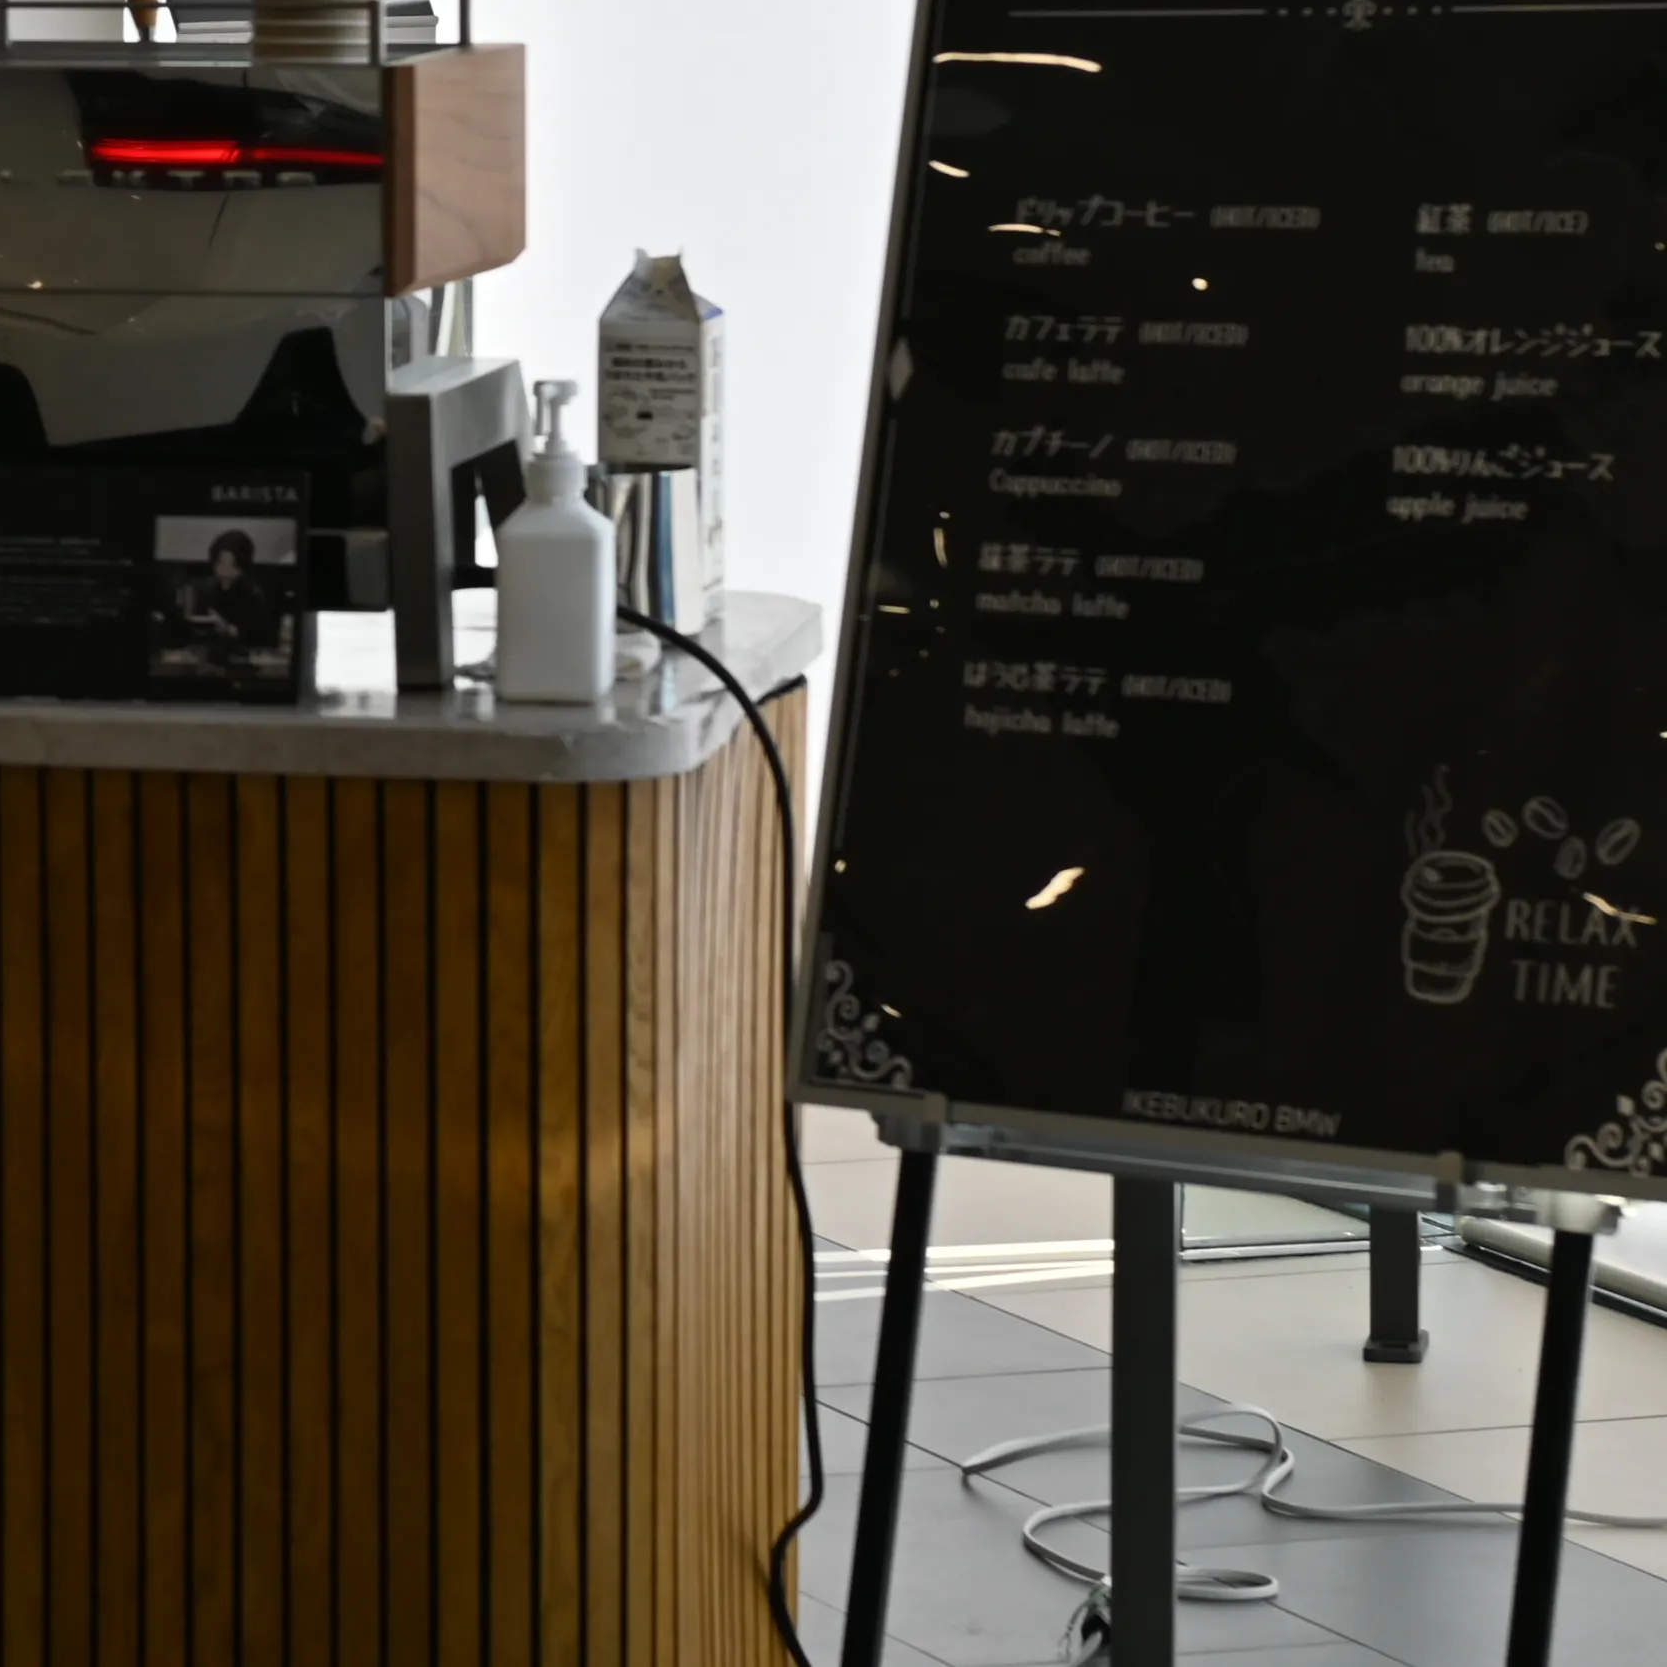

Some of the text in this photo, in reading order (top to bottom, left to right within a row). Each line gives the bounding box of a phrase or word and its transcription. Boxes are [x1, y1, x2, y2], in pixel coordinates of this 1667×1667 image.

[1004, 314, 1125, 345] カフェラテ
[1399, 370, 1560, 401] orange juice
[990, 424, 1115, 461] カプチーノ
[210, 484, 300, 504] BARISTA
[1384, 490, 1530, 525] apple juice
[1503, 897, 1641, 950] RELAX
[1510, 958, 1622, 1011] TIME
[1121, 1088, 1344, 1139] IKEBUKURO BMW
